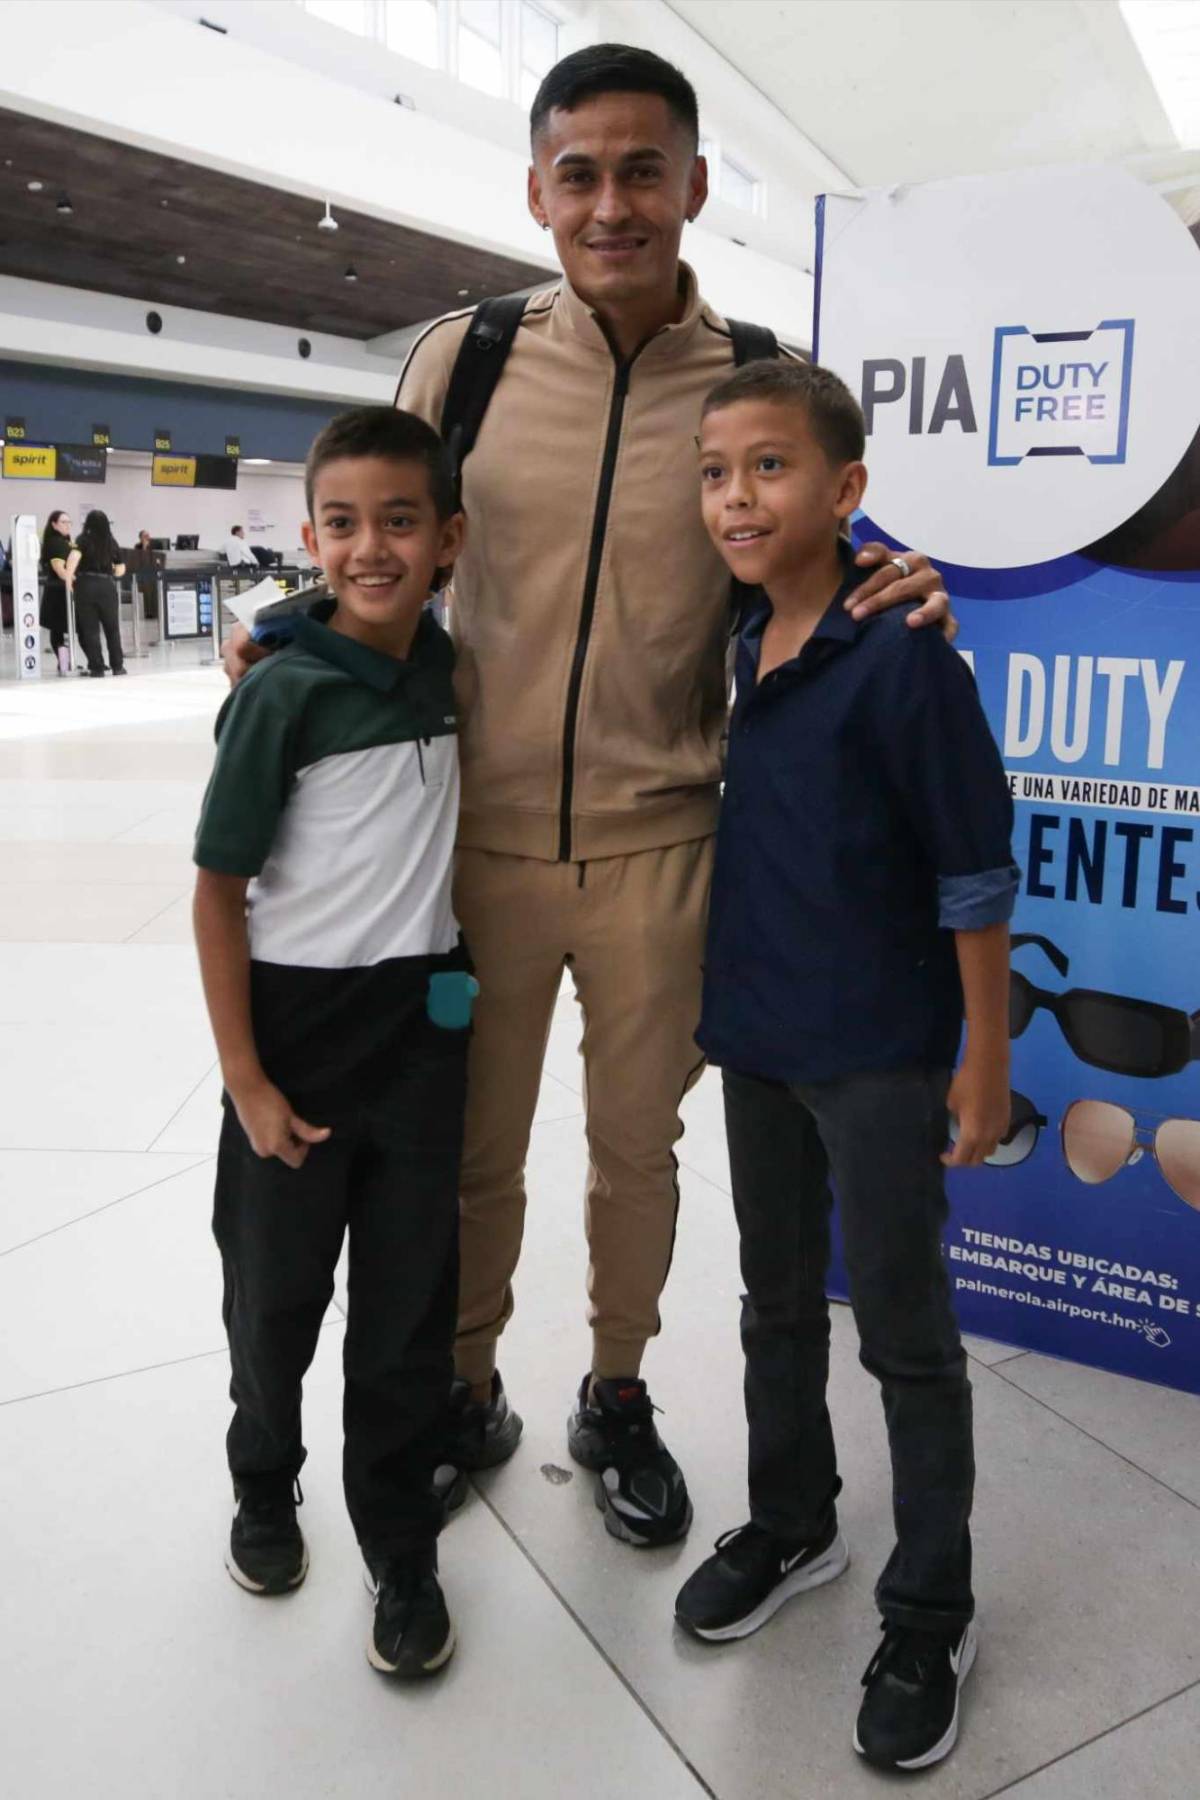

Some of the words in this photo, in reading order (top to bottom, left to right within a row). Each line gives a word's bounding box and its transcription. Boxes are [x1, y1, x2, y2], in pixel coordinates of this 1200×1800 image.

[861, 354, 978, 436] PIA
[1016, 361, 1109, 390] DUTY
[1014, 394, 1106, 422] FREE
[12, 454, 47, 466] spirit
[161, 463, 188, 474] spirit
[1004, 652, 1186, 769] DUTY
[1023, 776, 1055, 799] UNA
[1061, 780, 1141, 806] VARIEDAD
[1147, 787, 1169, 809] DE
[1016, 813, 1200, 914] ENTE
[949, 1245, 1067, 1285] EMBARQUE
[1072, 1273, 1087, 1289] Y
[1091, 1277, 1153, 1306] ÁREA
[1159, 1294, 1191, 1314] DE
[961, 1228, 1052, 1261] TIENDAS
[1057, 1249, 1179, 1290] UBICADAS:
[955, 1277, 1137, 1330] palmerola.airport.hn
